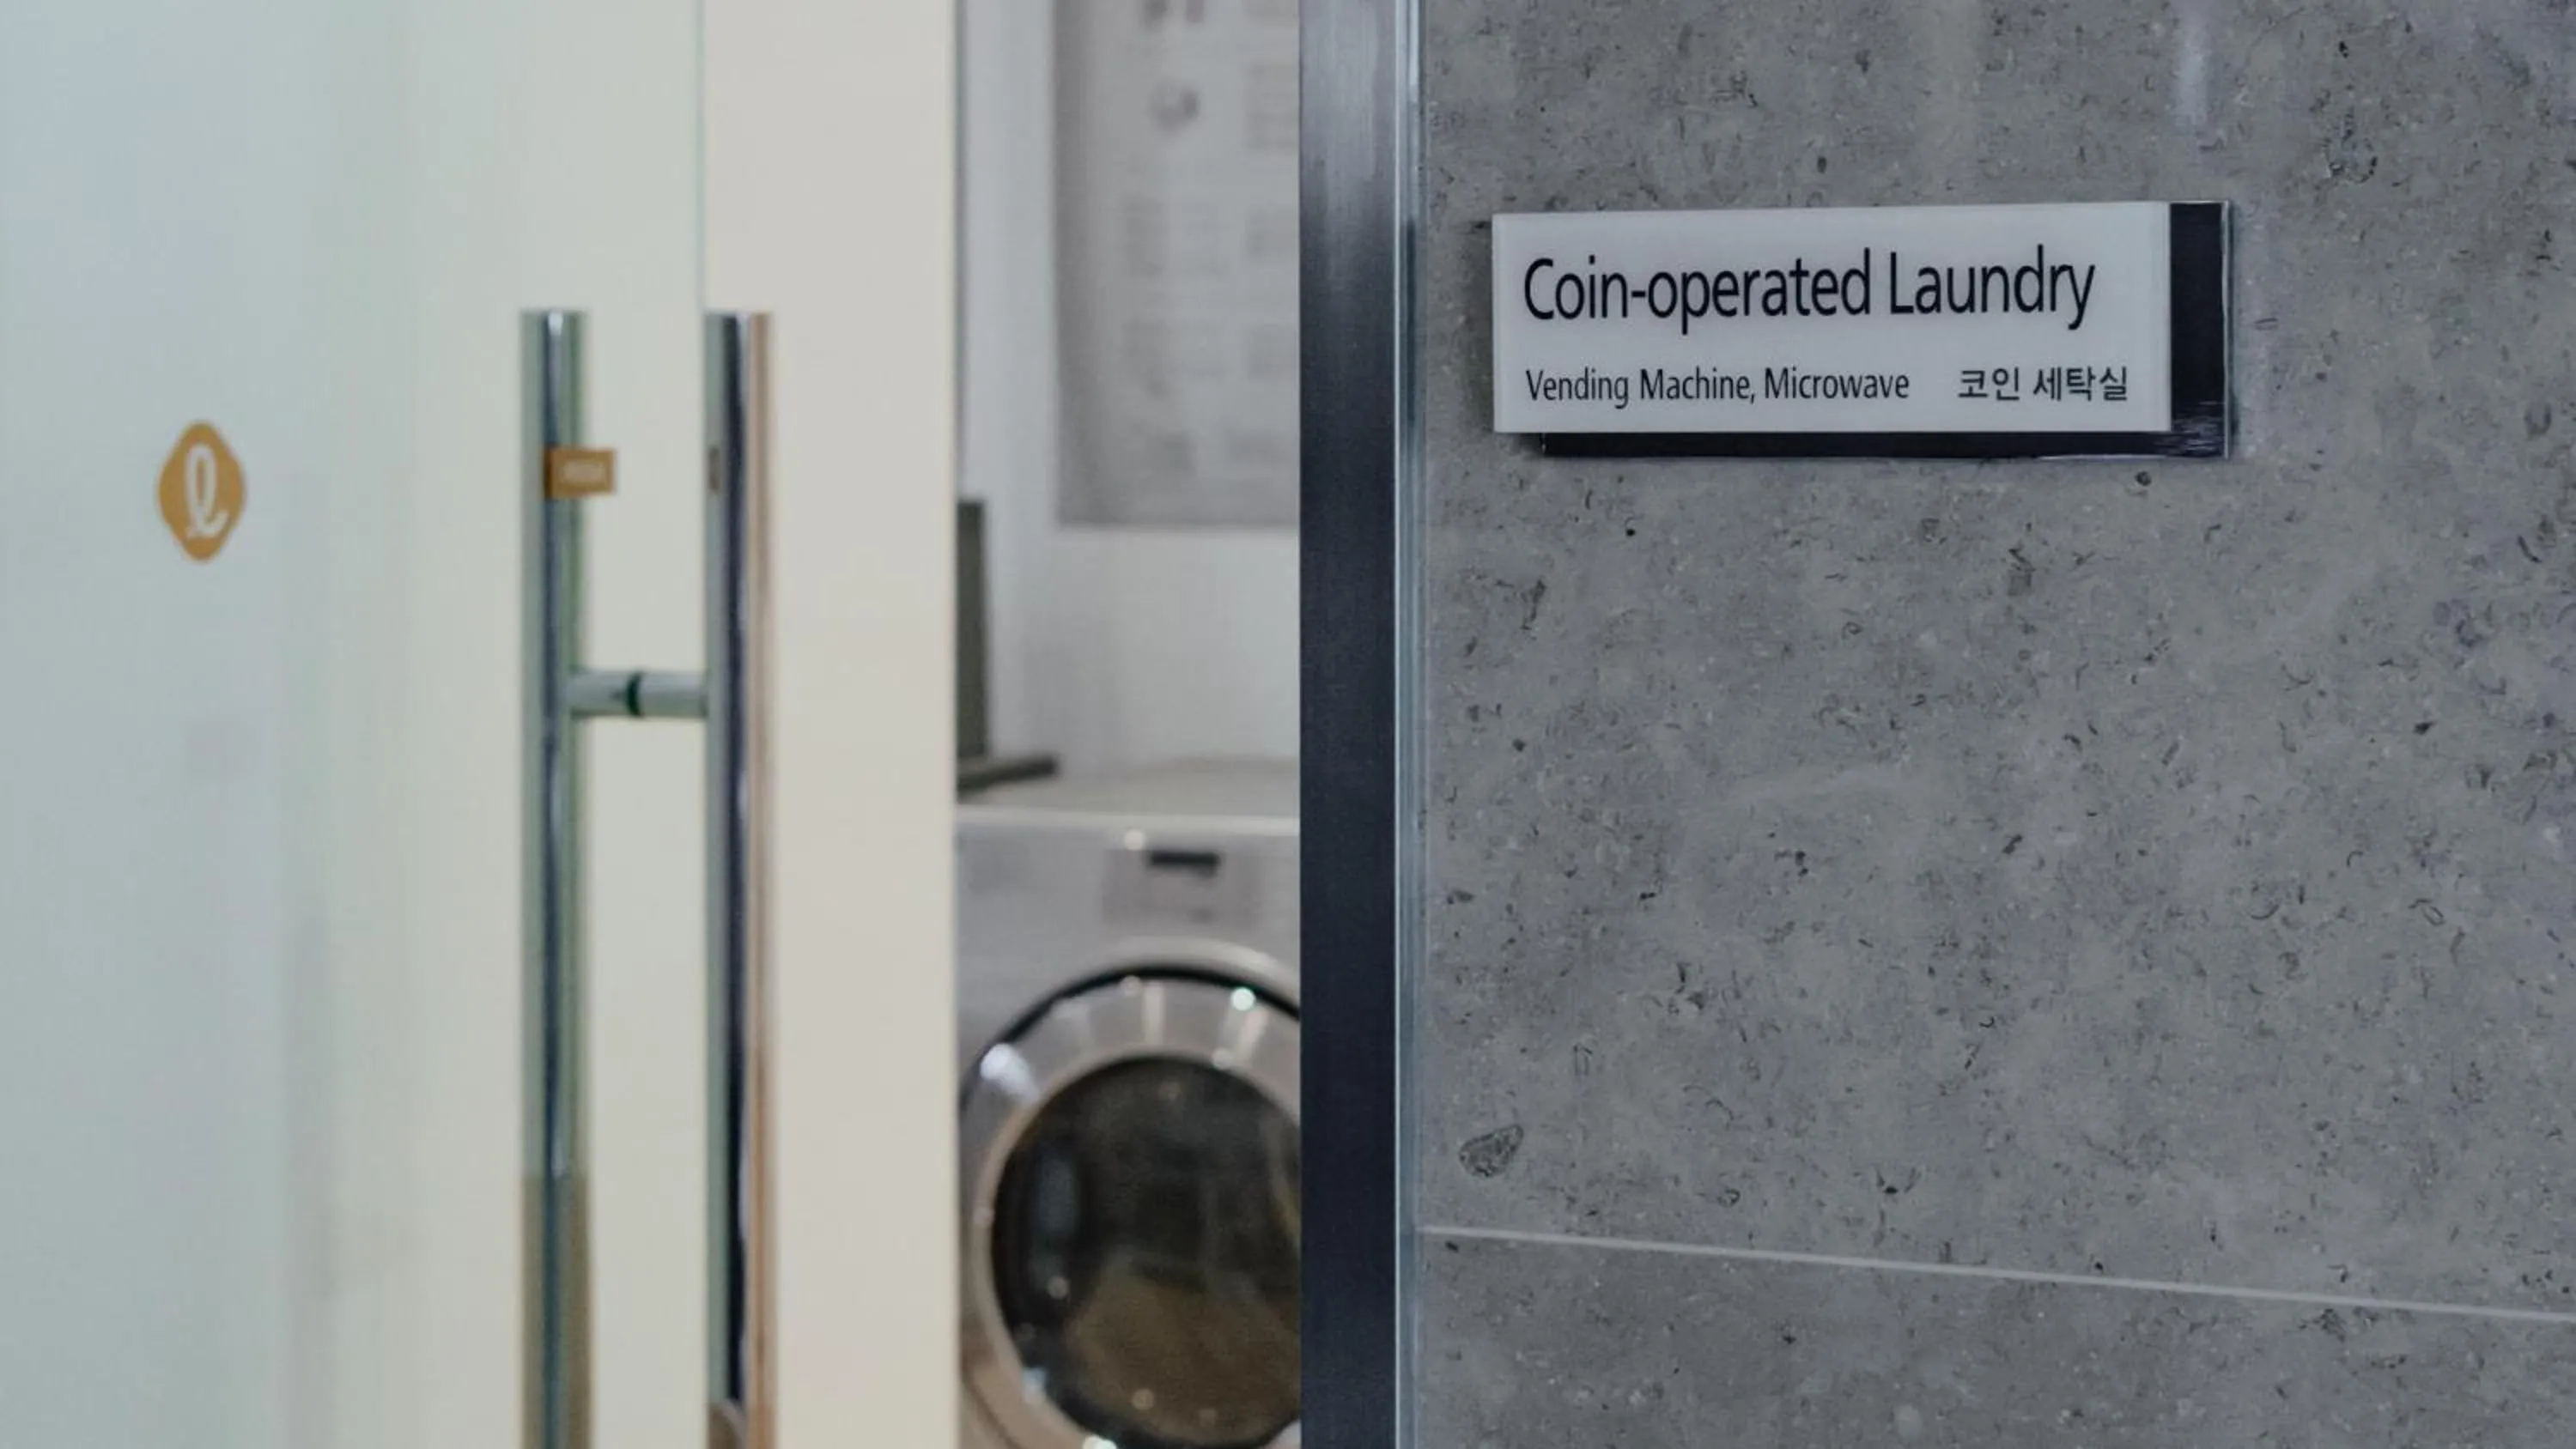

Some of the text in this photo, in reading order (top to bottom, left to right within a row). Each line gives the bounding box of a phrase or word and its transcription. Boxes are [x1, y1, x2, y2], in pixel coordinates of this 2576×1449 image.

[1523, 243, 2097, 336] Coin-operated Laundry
[1524, 365, 1911, 410] Vending Machine, Microwave
[1957, 365, 2128, 403] 코인 세탁실
